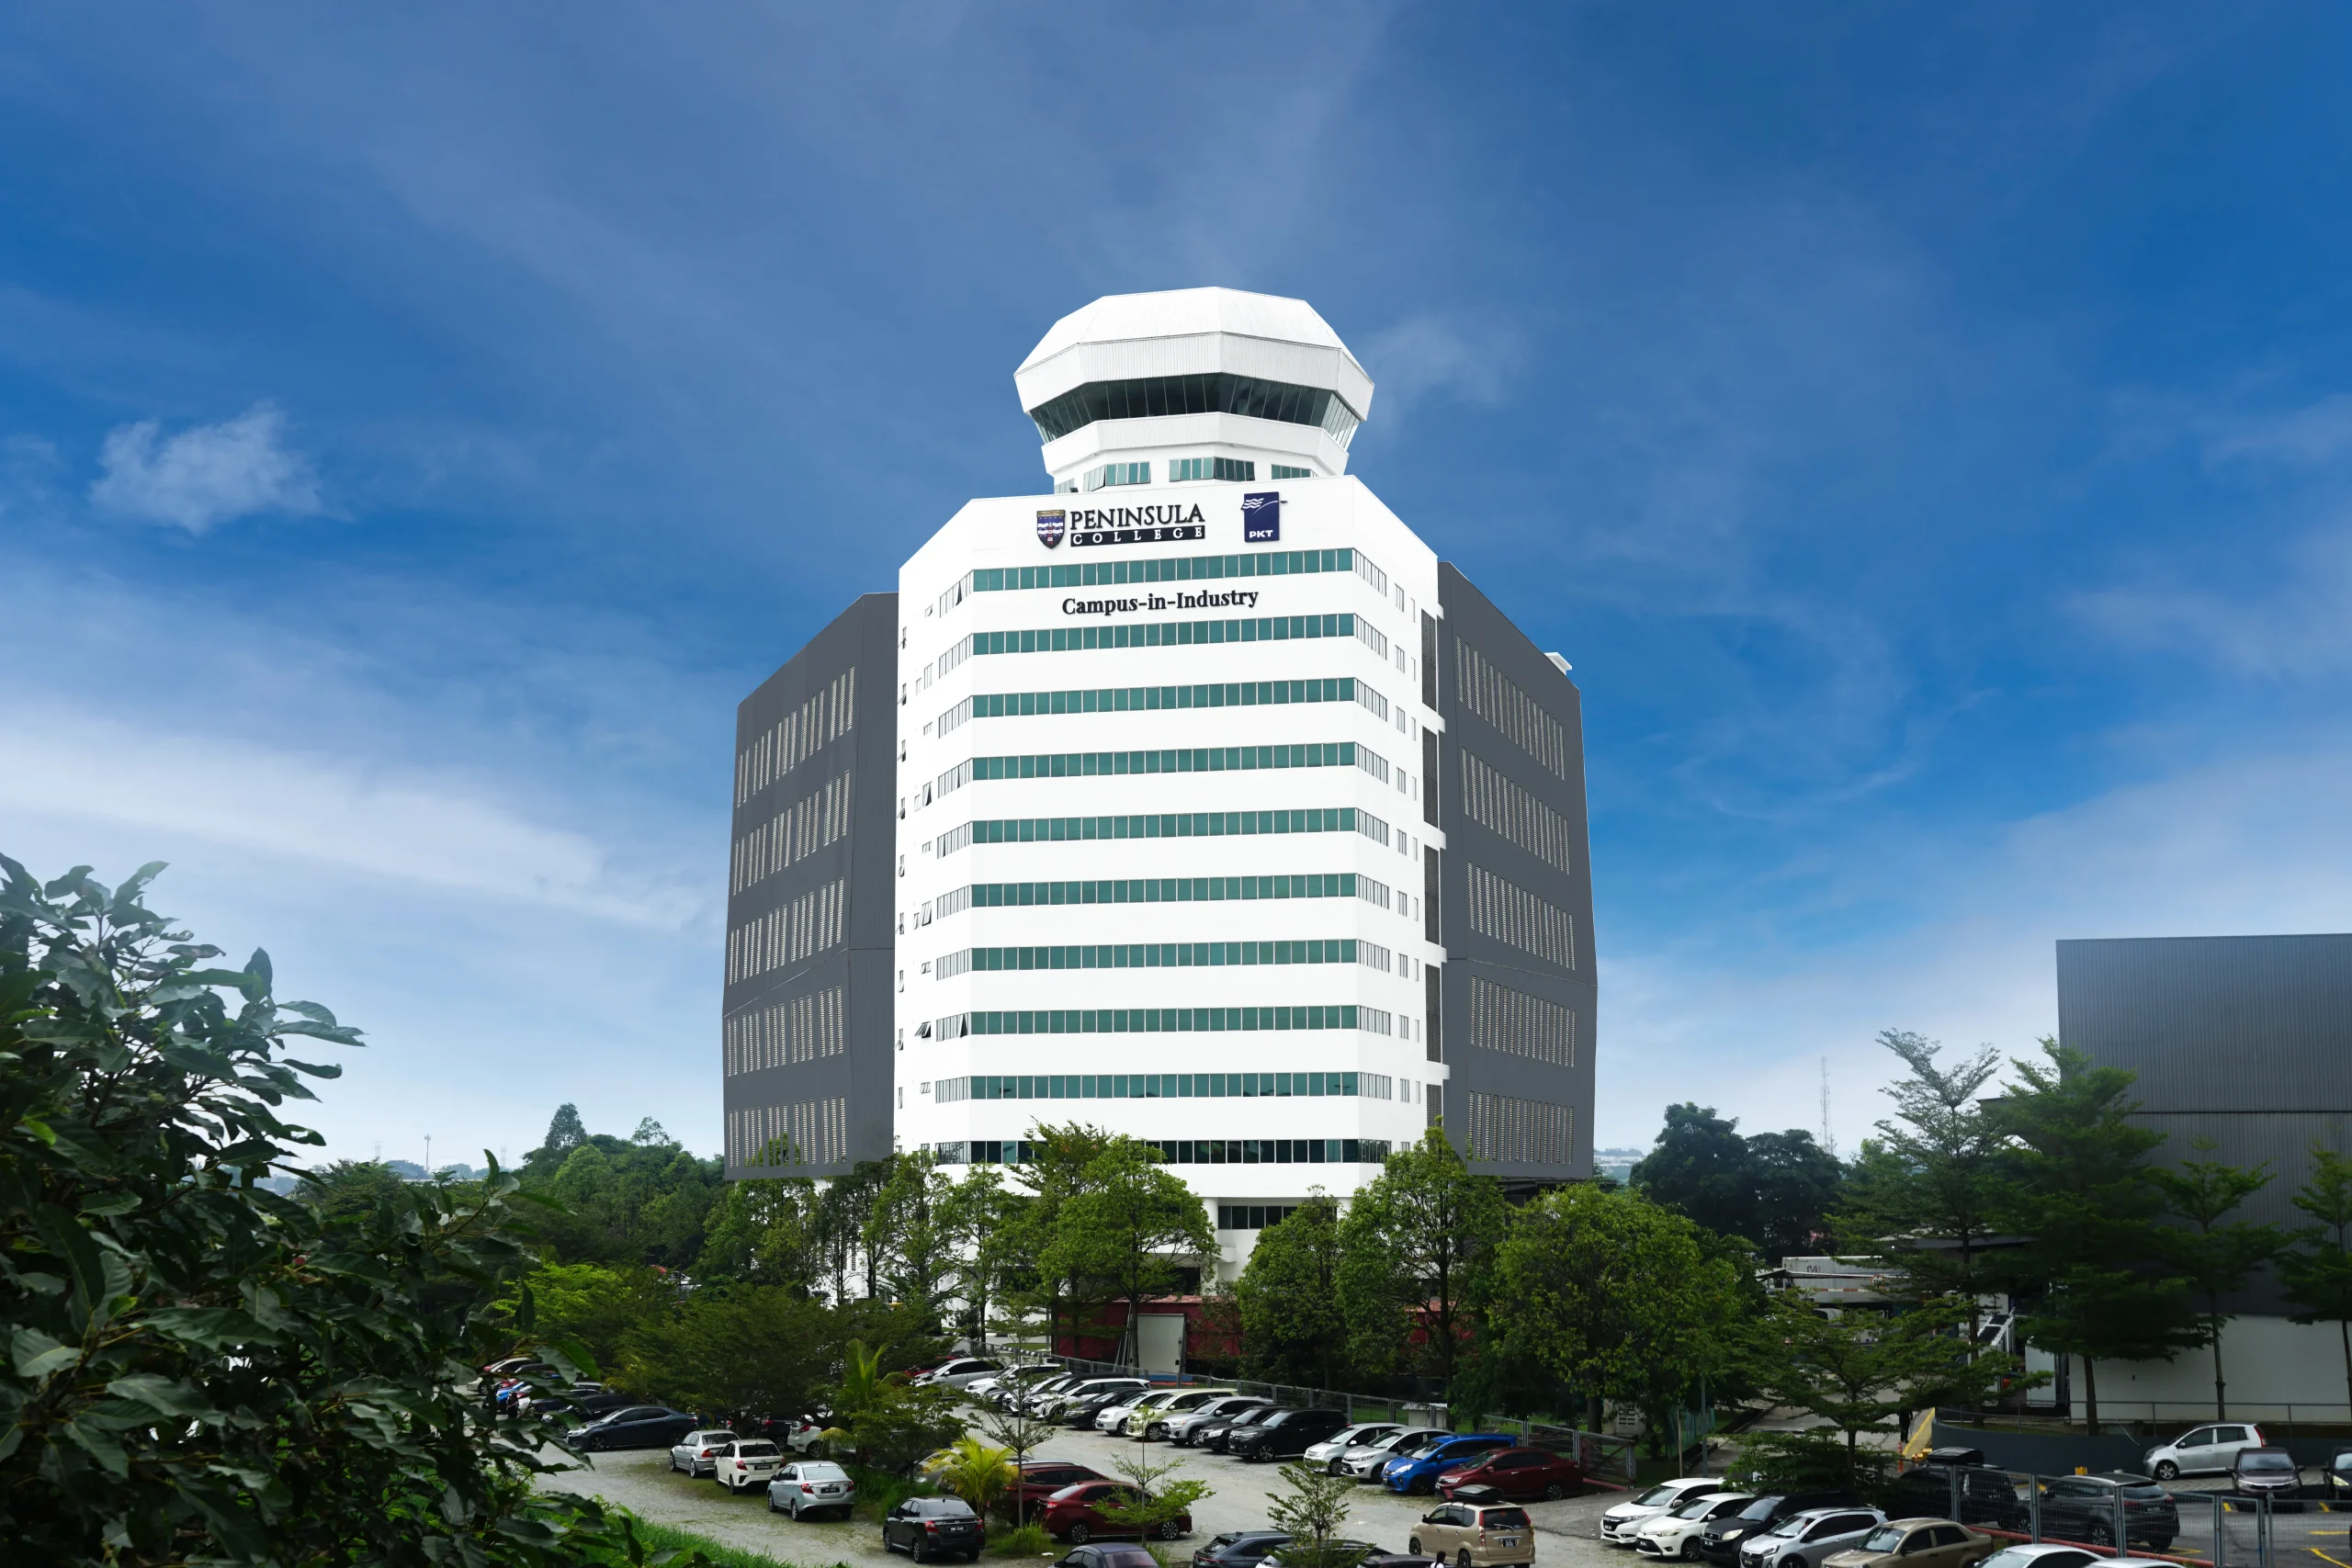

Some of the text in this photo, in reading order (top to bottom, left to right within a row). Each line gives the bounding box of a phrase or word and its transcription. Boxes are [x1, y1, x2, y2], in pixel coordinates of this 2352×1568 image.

[1070, 503, 1205, 530] PENINSULA
[1072, 526, 1203, 545] COLLEGE
[1250, 529, 1273, 538] PKT
[1062, 590, 1259, 615] Campus-in-Industry
